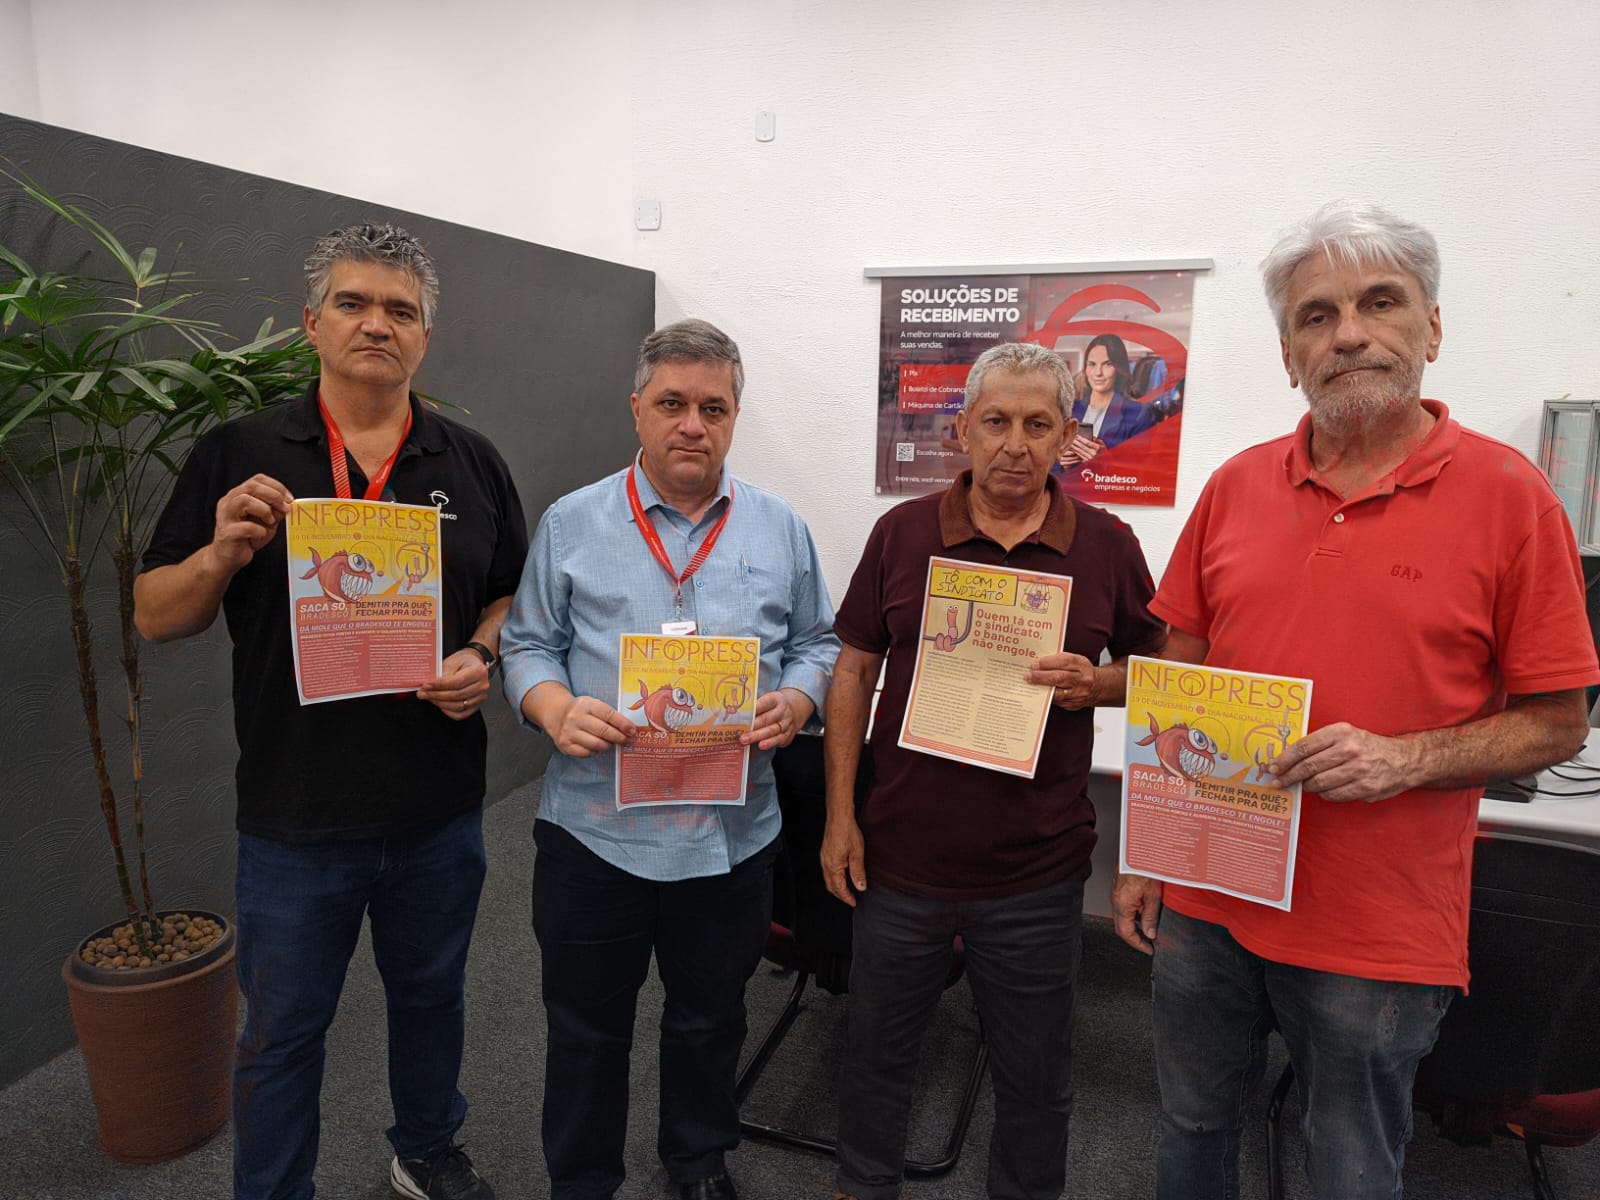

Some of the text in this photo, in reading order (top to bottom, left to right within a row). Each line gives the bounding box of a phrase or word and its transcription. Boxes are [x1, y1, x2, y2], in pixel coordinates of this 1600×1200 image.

[900, 284, 1018, 307] SOLUÇÕES DE
[900, 307, 1020, 323] RECEBIMENTO
[917, 341, 944, 349] vendas.
[1095, 474, 1137, 484] bradesco
[1131, 485, 1160, 493] negócios
[290, 504, 437, 532] INFOPRESS
[966, 575, 992, 588] COM
[997, 579, 1007, 588] O
[1391, 564, 1423, 582] GAP
[936, 581, 1004, 600] SINDICATO
[300, 603, 329, 613] SACA
[356, 601, 390, 609] DEMITIR
[392, 601, 409, 609] PRA
[976, 609, 1053, 630] Quem tá com
[984, 630, 1019, 644] banco
[624, 639, 757, 663] INFOPRESS
[972, 638, 1039, 659] não engole.
[1131, 662, 1304, 712] INFOPRESS
[1133, 771, 1165, 783] SACA
[1133, 780, 1186, 795] BRADESCO
[1195, 780, 1288, 805] DEMITIR PRA QUÊ?
[1144, 794, 1165, 804] MOLE
[1167, 800, 1184, 808] QUE
[1193, 804, 1236, 817] BRADESCO
[1249, 814, 1285, 827] ENGOLE!
[1194, 790, 1288, 814] FECHAR PRA QUÊ?
